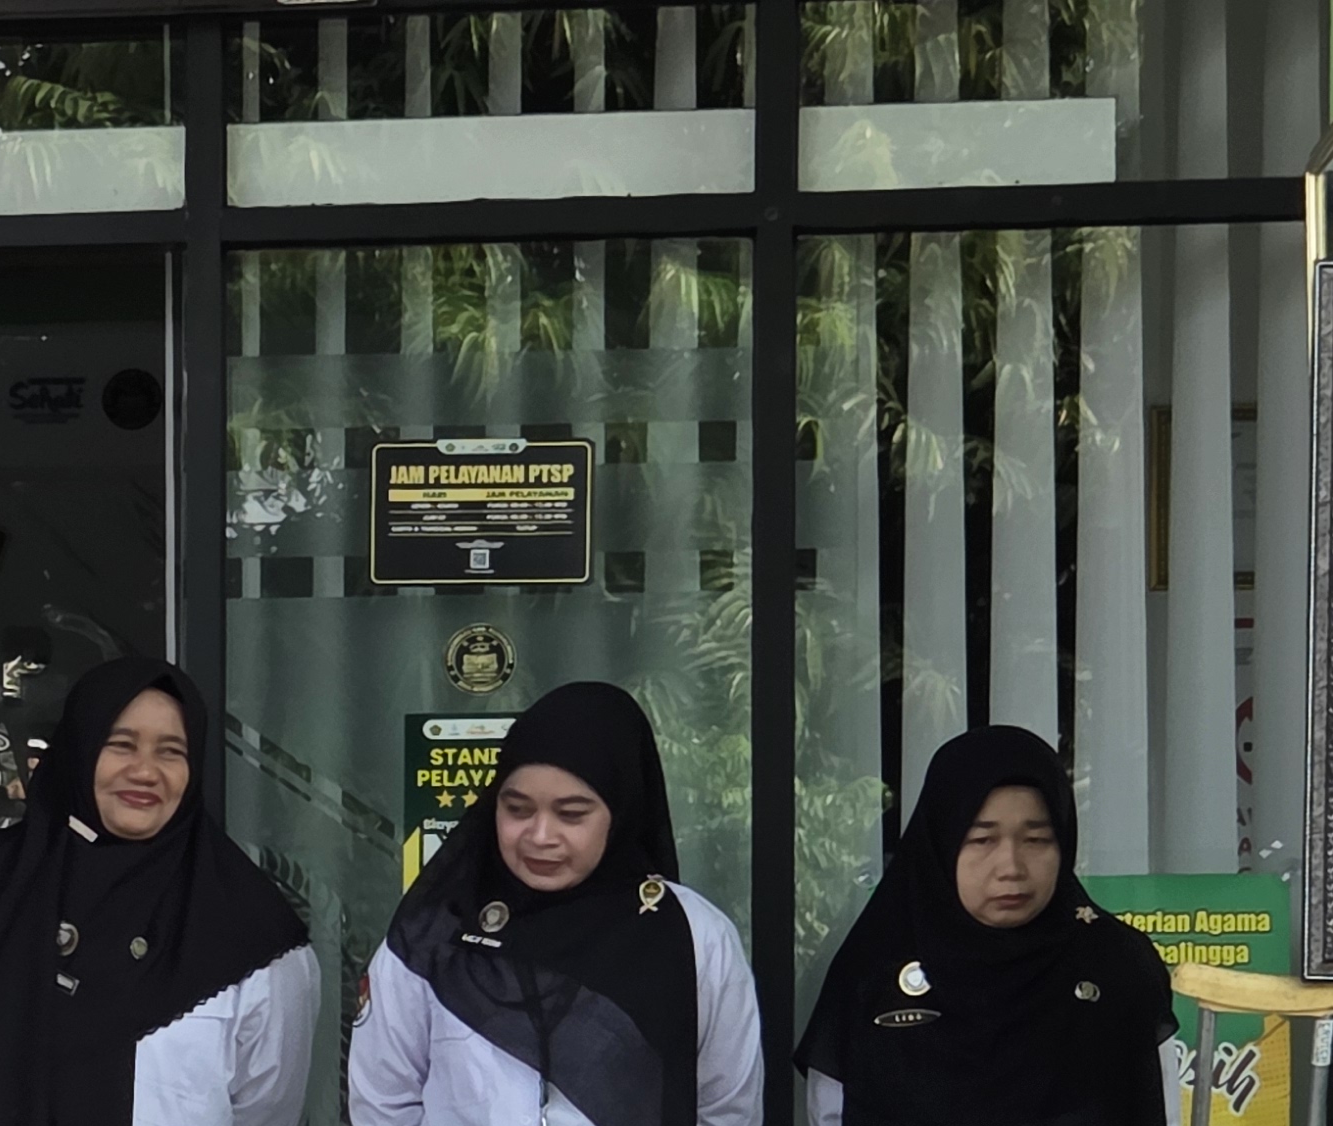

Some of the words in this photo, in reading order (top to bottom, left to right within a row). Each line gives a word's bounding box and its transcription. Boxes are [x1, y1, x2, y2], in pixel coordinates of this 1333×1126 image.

[390, 465, 425, 484] JAM
[428, 464, 525, 484] PELAYANAN
[528, 463, 574, 483] PTSP
[1194, 910, 1271, 935] Agama
